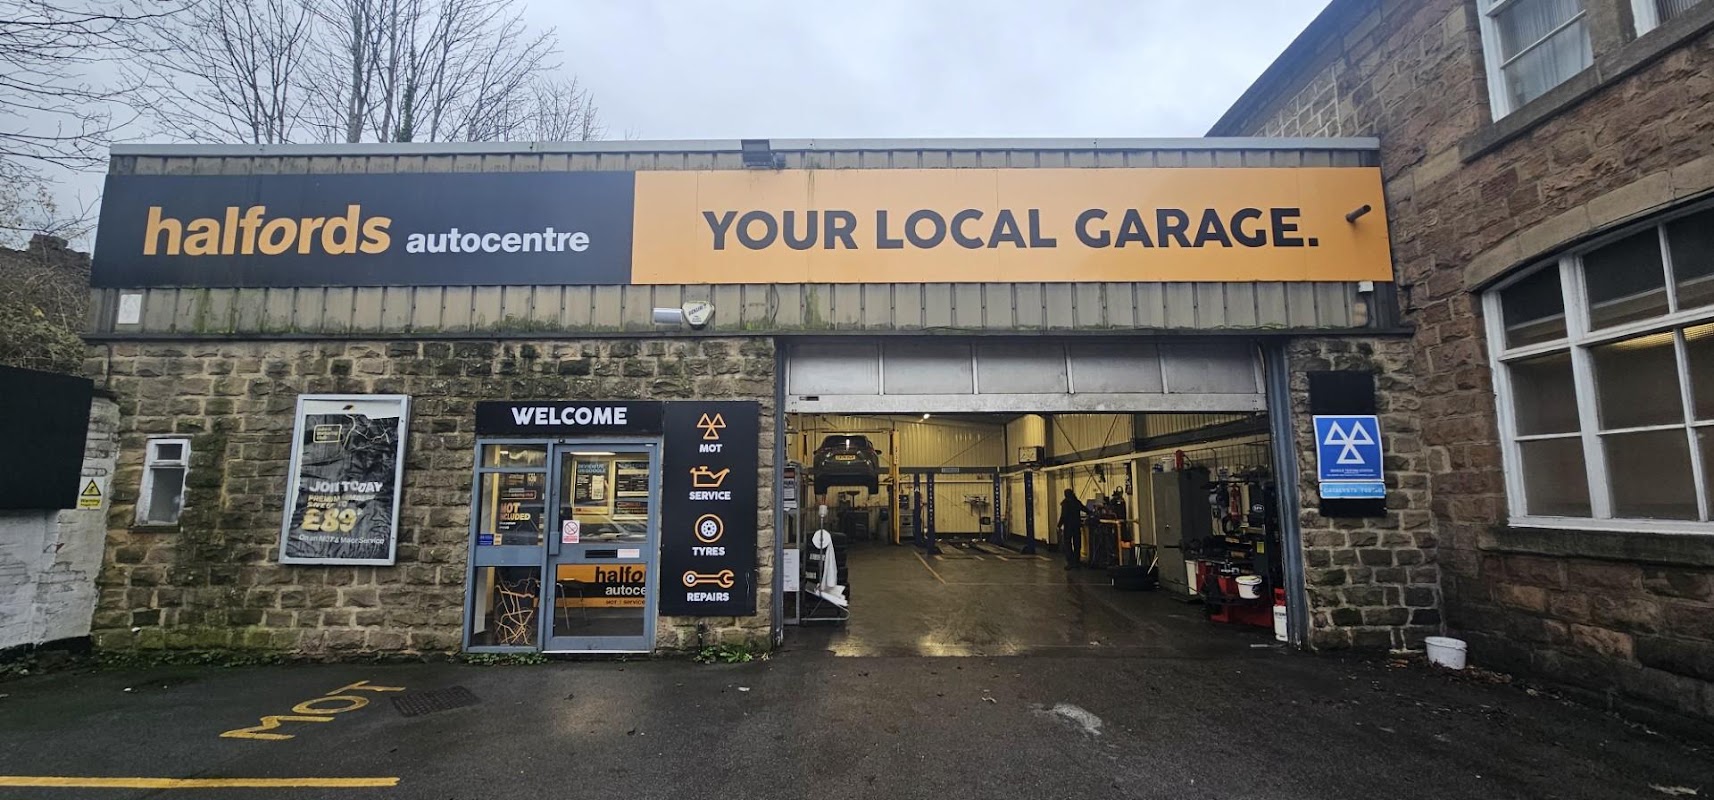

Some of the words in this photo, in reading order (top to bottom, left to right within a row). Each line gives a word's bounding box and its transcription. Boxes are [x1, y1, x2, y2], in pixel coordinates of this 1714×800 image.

[143, 204, 392, 256] halfords
[406, 227, 590, 254] autocentre
[702, 208, 858, 251] YOUR
[876, 207, 1056, 250] LOCAL
[1074, 206, 1319, 249] GARAGE.
[511, 406, 628, 426] WELCOME
[699, 444, 722, 453] MOT
[341, 480, 384, 493] TODAY
[688, 491, 731, 501] SERVICE
[692, 546, 726, 556] TYRES
[595, 566, 646, 583] halfo
[687, 592, 730, 602] REPAIRS
[218, 679, 407, 741] MOT
